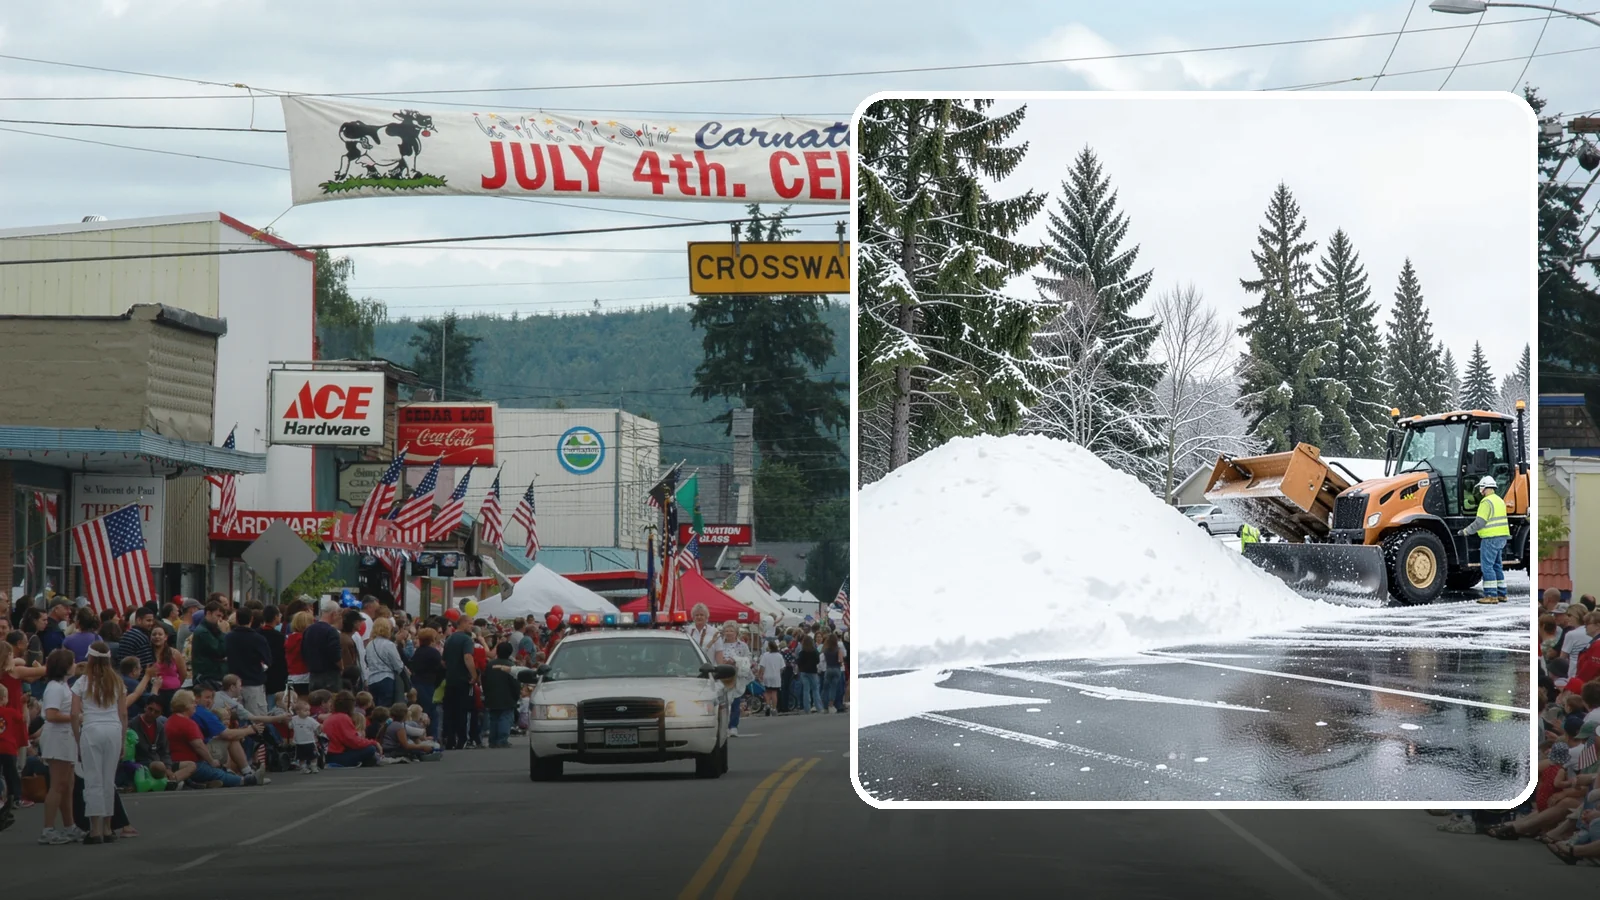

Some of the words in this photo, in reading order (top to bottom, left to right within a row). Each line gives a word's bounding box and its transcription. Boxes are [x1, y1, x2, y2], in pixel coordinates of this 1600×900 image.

[695, 121, 850, 150] Carnat
[481, 141, 605, 192] JULY
[632, 150, 746, 198] 4th.
[697, 254, 850, 280] CROSSWA
[282, 380, 374, 420] ACE
[405, 409, 452, 422] CEDAR
[283, 421, 371, 436] Hardware
[416, 428, 477, 446] Coca-Cola
[83, 485, 93, 494] St.
[95, 485, 124, 495] Vincent
[126, 486, 136, 495] de
[137, 486, 155, 495] Paul
[688, 526, 742, 535] CRNATION
[699, 535, 730, 543] GLASS
